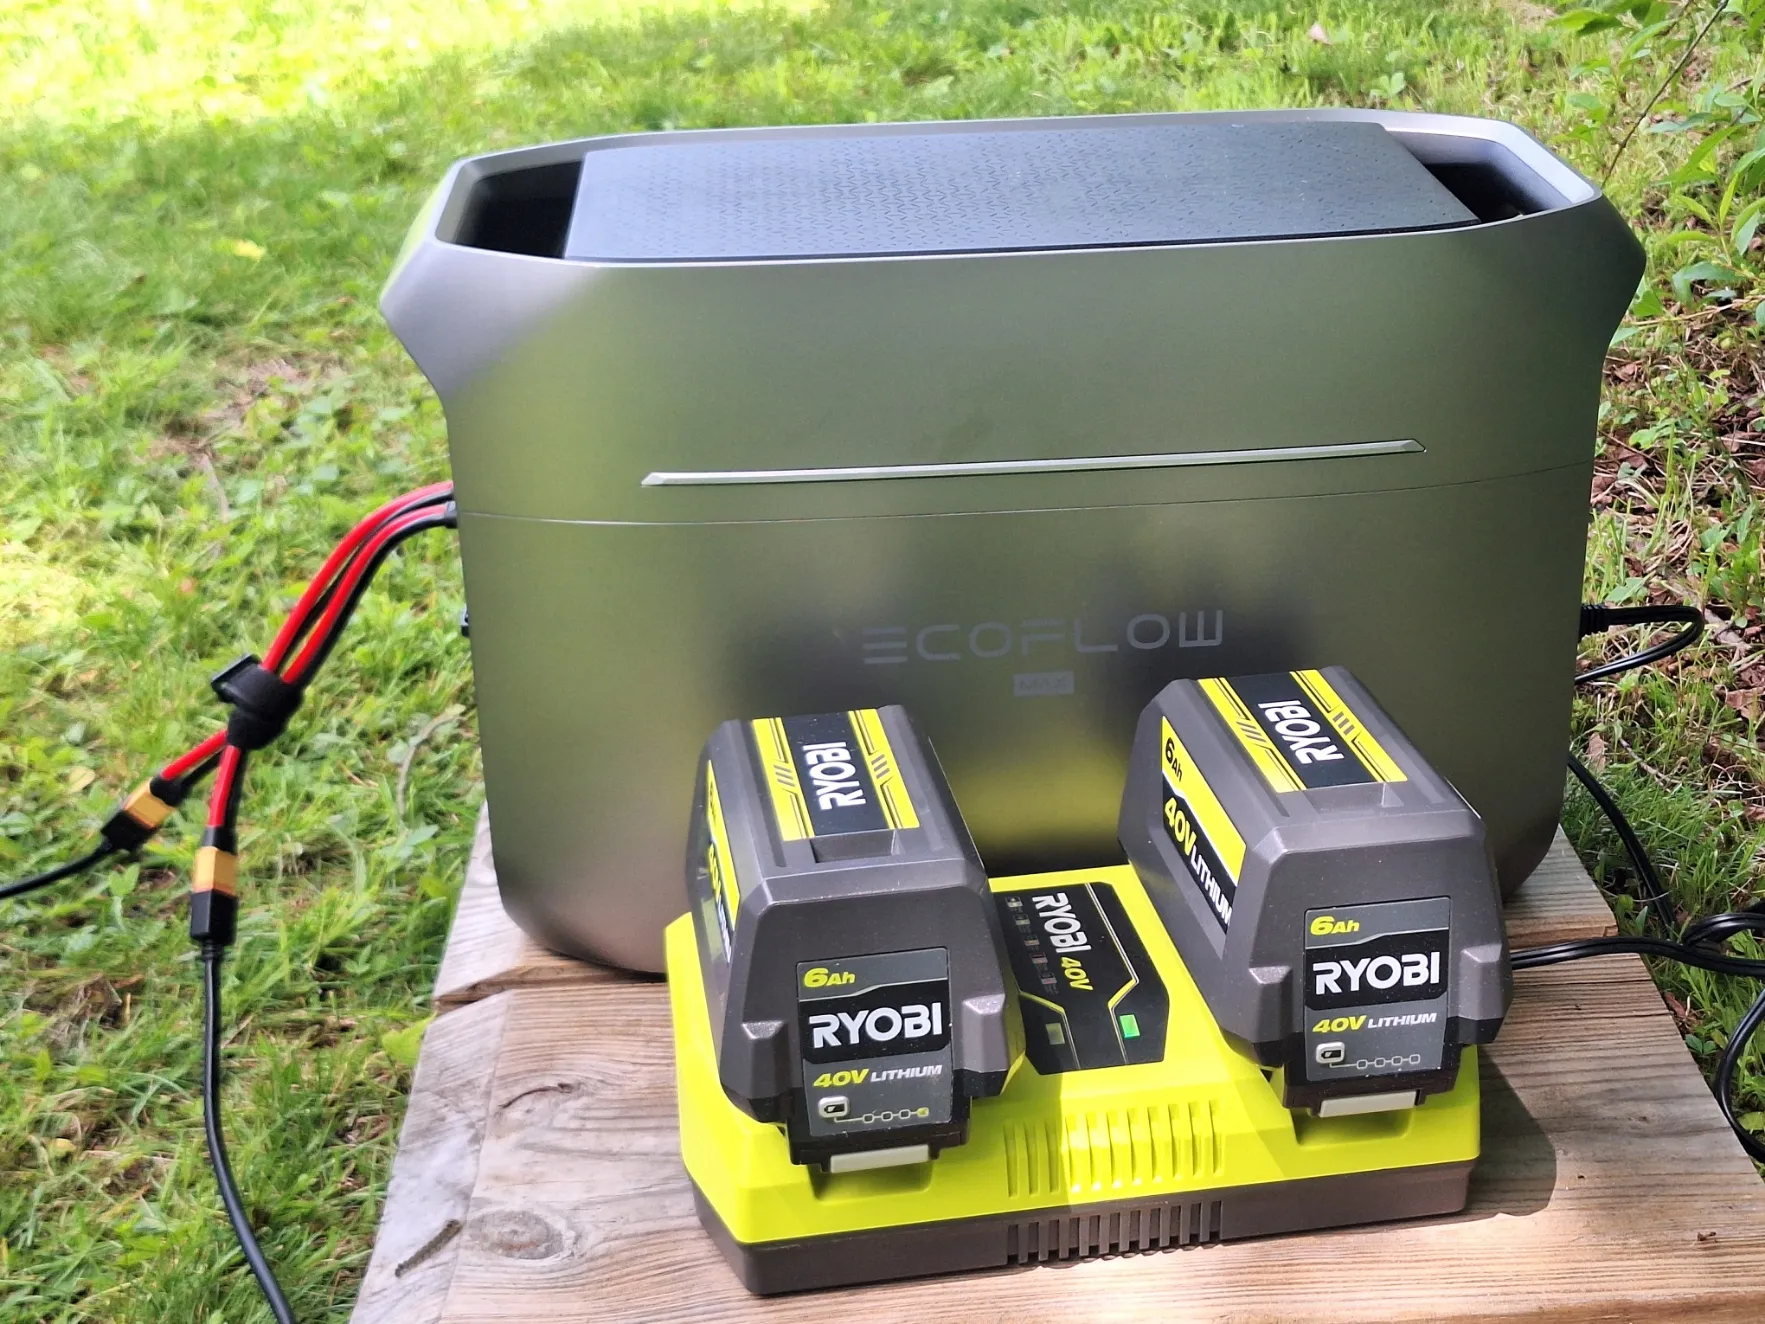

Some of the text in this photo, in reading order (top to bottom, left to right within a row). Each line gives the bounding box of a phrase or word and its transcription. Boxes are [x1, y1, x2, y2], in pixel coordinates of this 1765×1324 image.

[861, 610, 1223, 664] ECOFLOW
[1258, 700, 1345, 764] RYOBI
[802, 741, 867, 811] RYOBI
[1165, 737, 1183, 782] 6Ah
[1164, 797, 1197, 856] 40V
[1032, 892, 1092, 953] RYOBI
[1310, 915, 1360, 935] 6Ah
[804, 967, 856, 988] 6Ah
[1061, 956, 1094, 991] 40V
[1312, 951, 1441, 995] RYOBI
[808, 1002, 943, 1049] RYOBI
[1312, 1012, 1438, 1033] 40V LITHIUM
[812, 1064, 943, 1088] 40V LITHIUM
